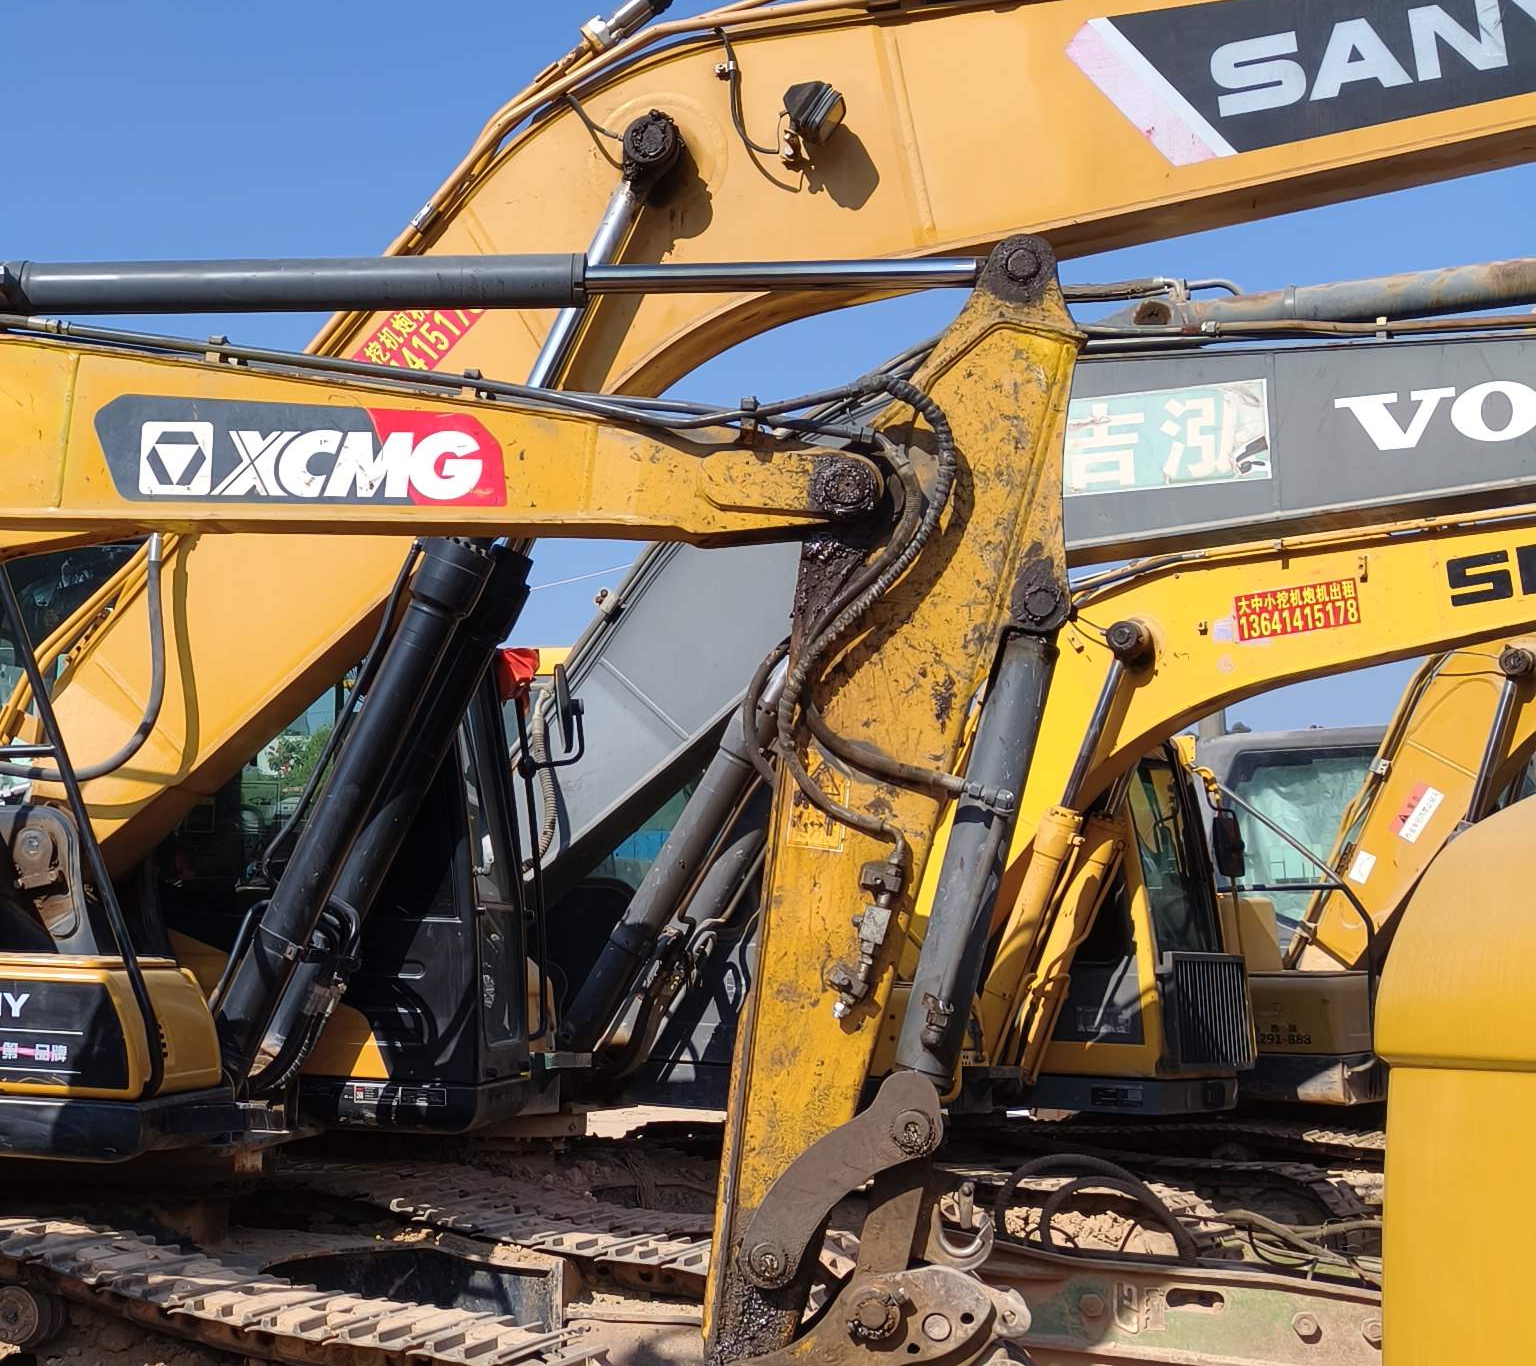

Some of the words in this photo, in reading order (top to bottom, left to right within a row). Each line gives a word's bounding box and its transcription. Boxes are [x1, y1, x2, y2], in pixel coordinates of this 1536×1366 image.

[210, 428, 483, 500] XCMG
[1238, 580, 1356, 615] 大中小挖机炮机出租
[1446, 543, 1536, 607] S
[1240, 598, 1359, 639] 13641415178
